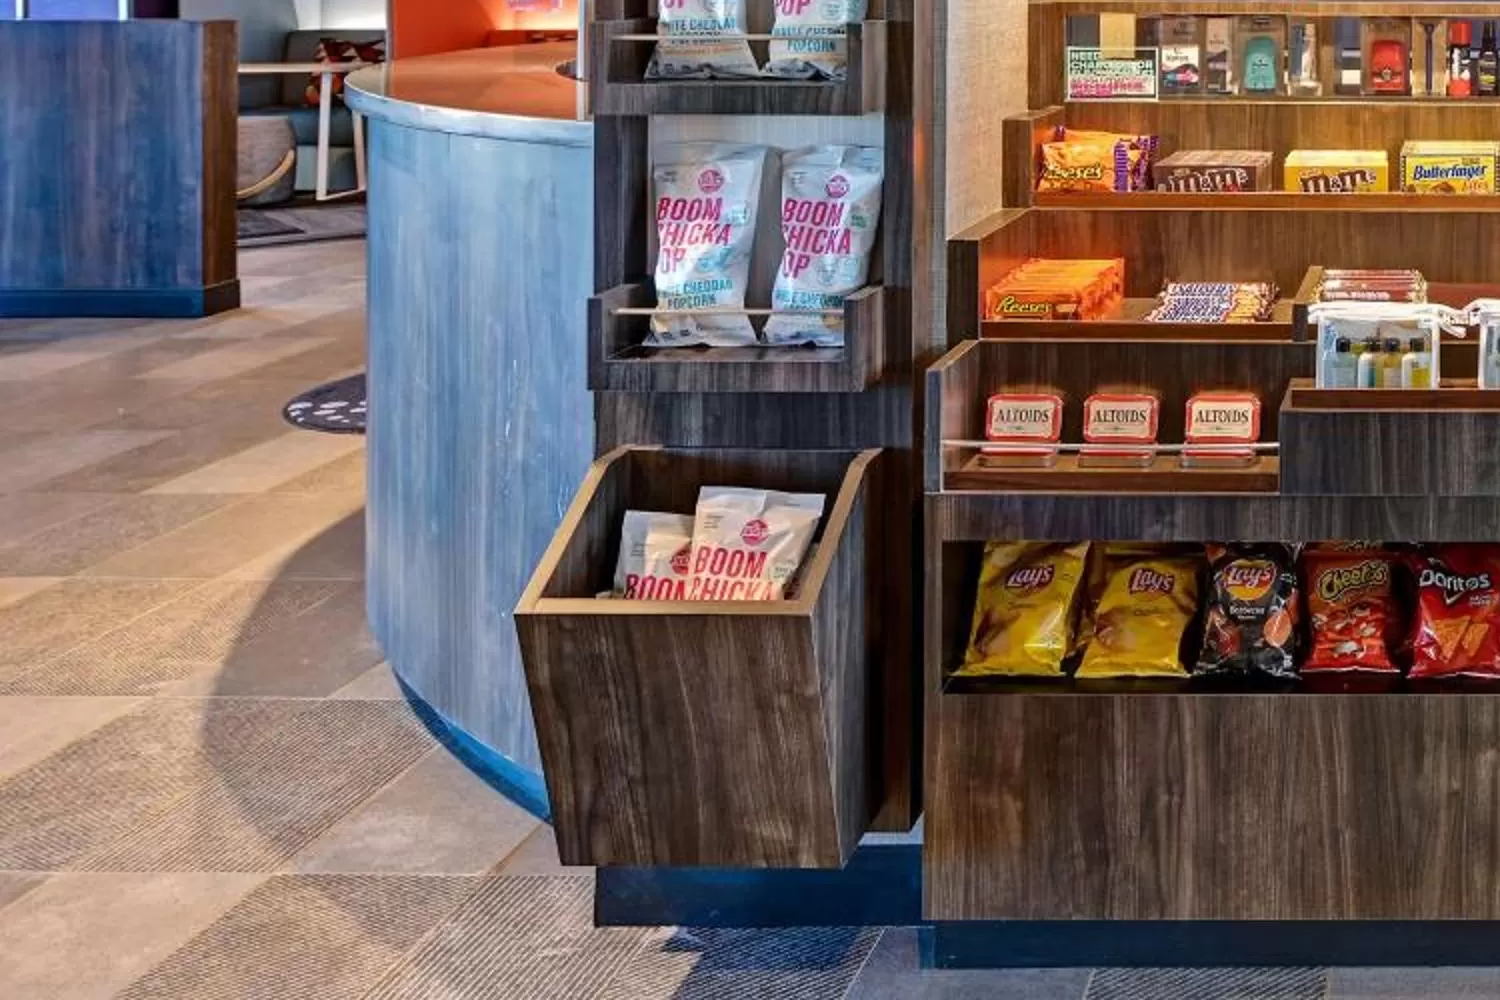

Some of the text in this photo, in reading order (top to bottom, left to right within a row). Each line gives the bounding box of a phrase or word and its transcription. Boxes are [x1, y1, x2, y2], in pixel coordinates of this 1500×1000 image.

[1413, 163, 1488, 181] Butterfinger
[656, 197, 724, 222] BOOM
[783, 198, 846, 226] BOOM
[657, 223, 732, 246] HICKA
[659, 247, 688, 274] OP
[783, 252, 811, 279] OP
[997, 408, 1050, 424] ALTOIDS
[1093, 409, 1147, 424] ALTOIDS
[1194, 409, 1249, 424] ALTOIDS
[694, 545, 769, 578] BOOM
[1130, 568, 1175, 592] Lay's
[1226, 566, 1272, 588] Lay's
[1419, 569, 1492, 592] Doritos
